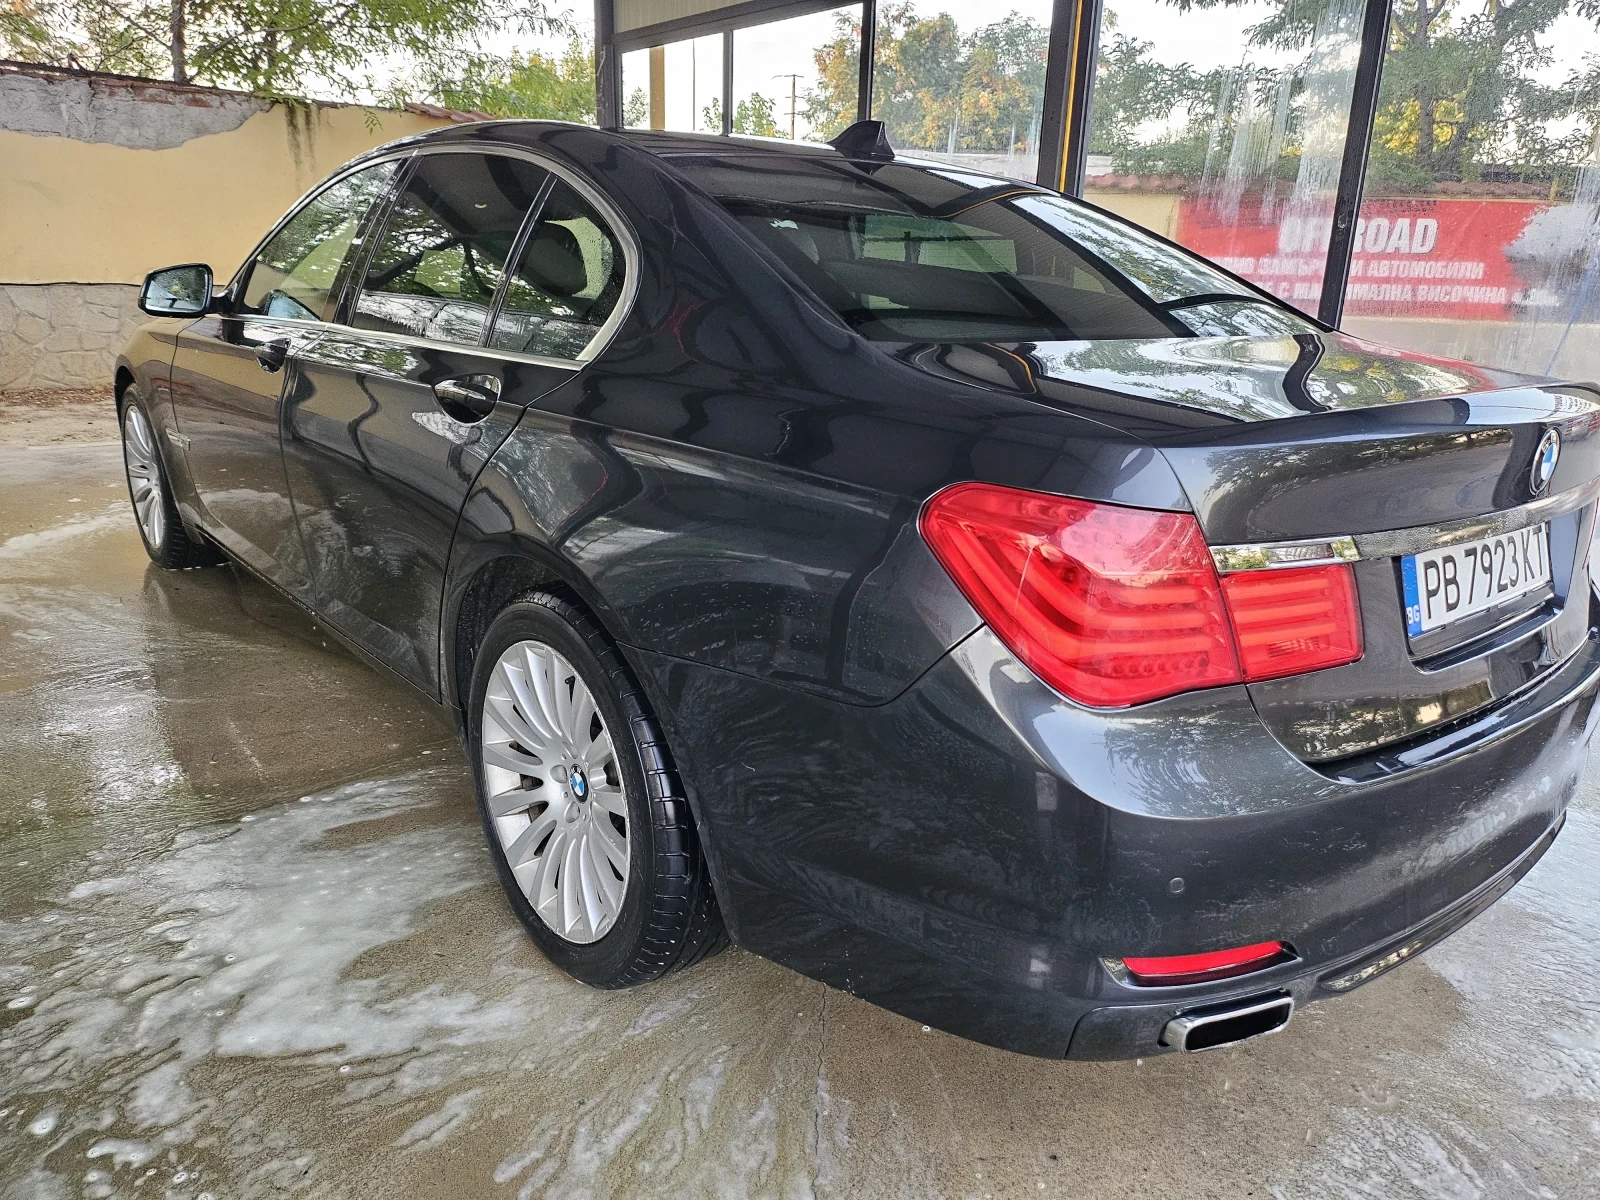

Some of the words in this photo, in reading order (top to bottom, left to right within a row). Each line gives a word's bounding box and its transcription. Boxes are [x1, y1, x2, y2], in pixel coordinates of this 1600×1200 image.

[1367, 260, 1485, 280] АВТОМОБИЛИ
[1416, 285, 1507, 304] ВИСОЧИНА
[1406, 605, 1421, 625] BG
